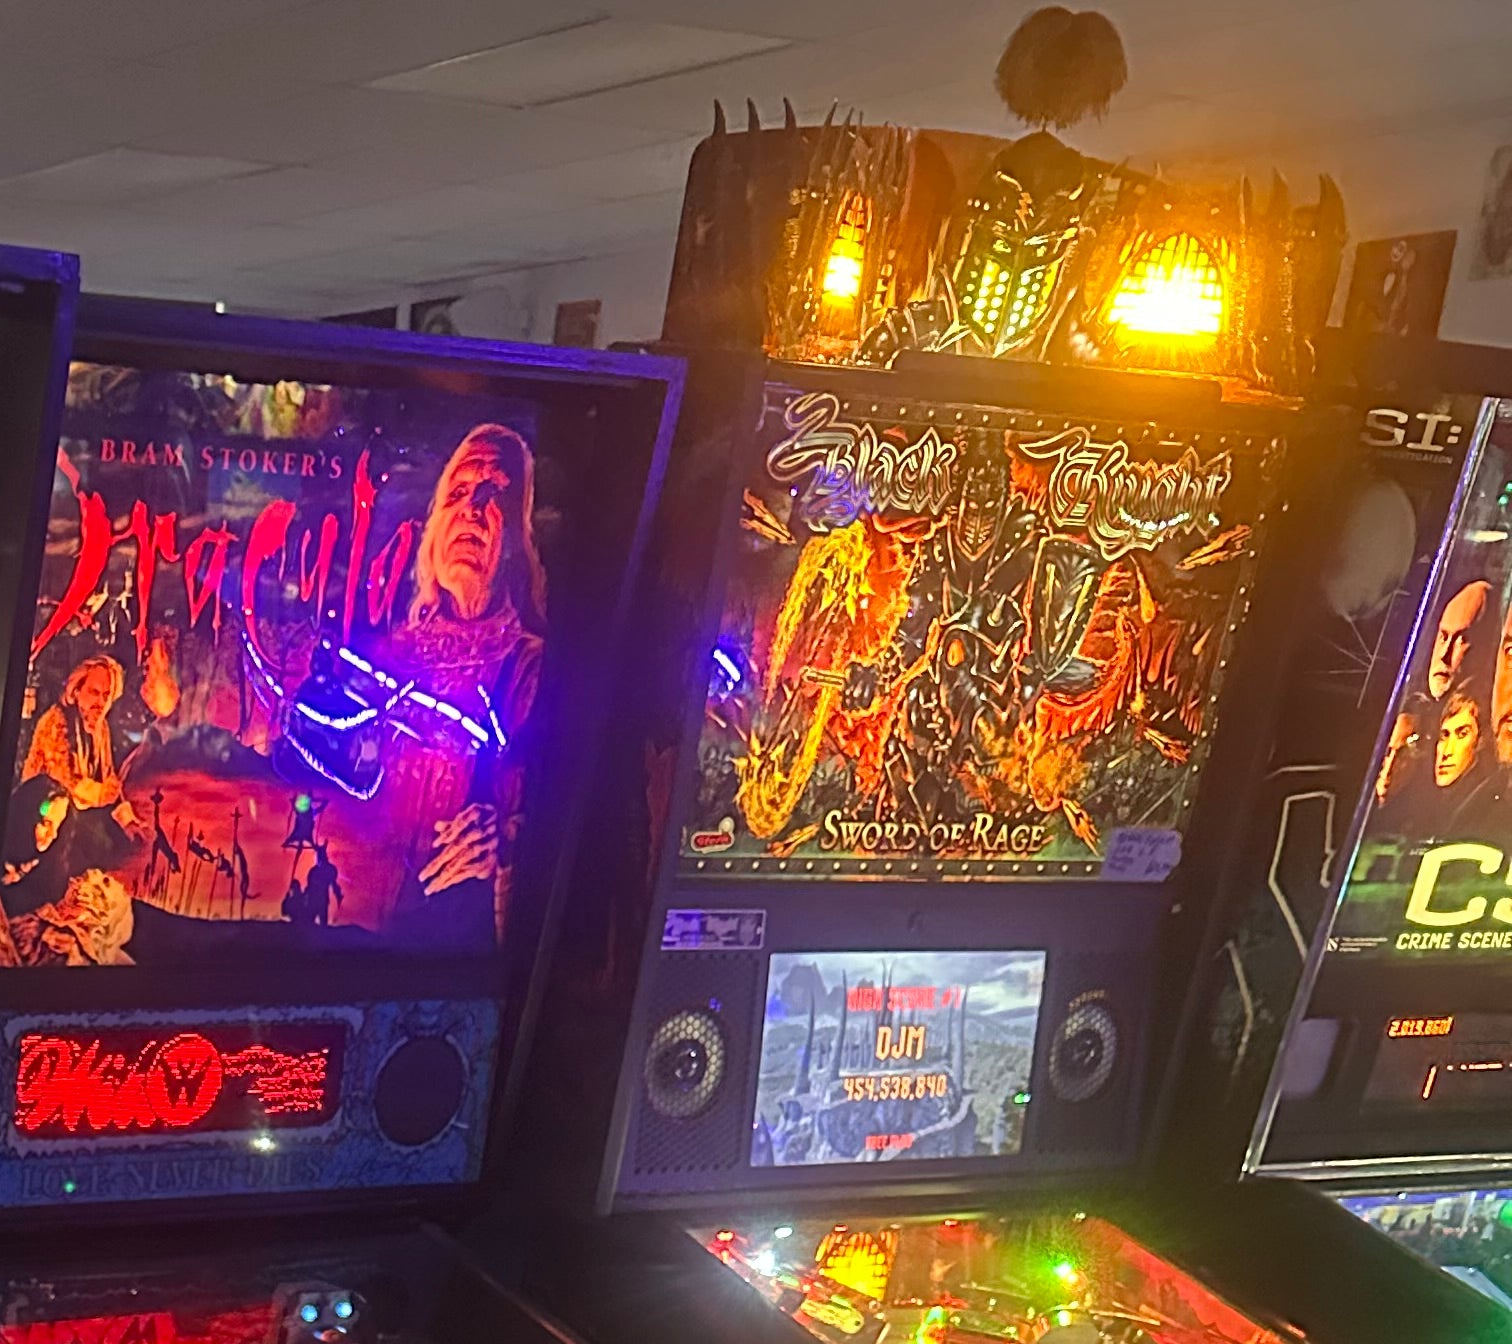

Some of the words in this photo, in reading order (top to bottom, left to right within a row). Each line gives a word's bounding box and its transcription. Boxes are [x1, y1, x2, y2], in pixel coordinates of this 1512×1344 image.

[99, 437, 185, 470] BRAM
[200, 444, 345, 482] STOKER'S
[766, 390, 958, 532] Black
[1017, 425, 1232, 561] Knight
[31, 442, 422, 672] Dracula
[820, 809, 921, 852] SWORD
[929, 824, 965, 852] OF
[971, 812, 1050, 854] RAGE
[1395, 932, 1455, 951] CRIME
[1457, 931, 1512, 950] SCENE
[875, 1026, 927, 1061] DJM
